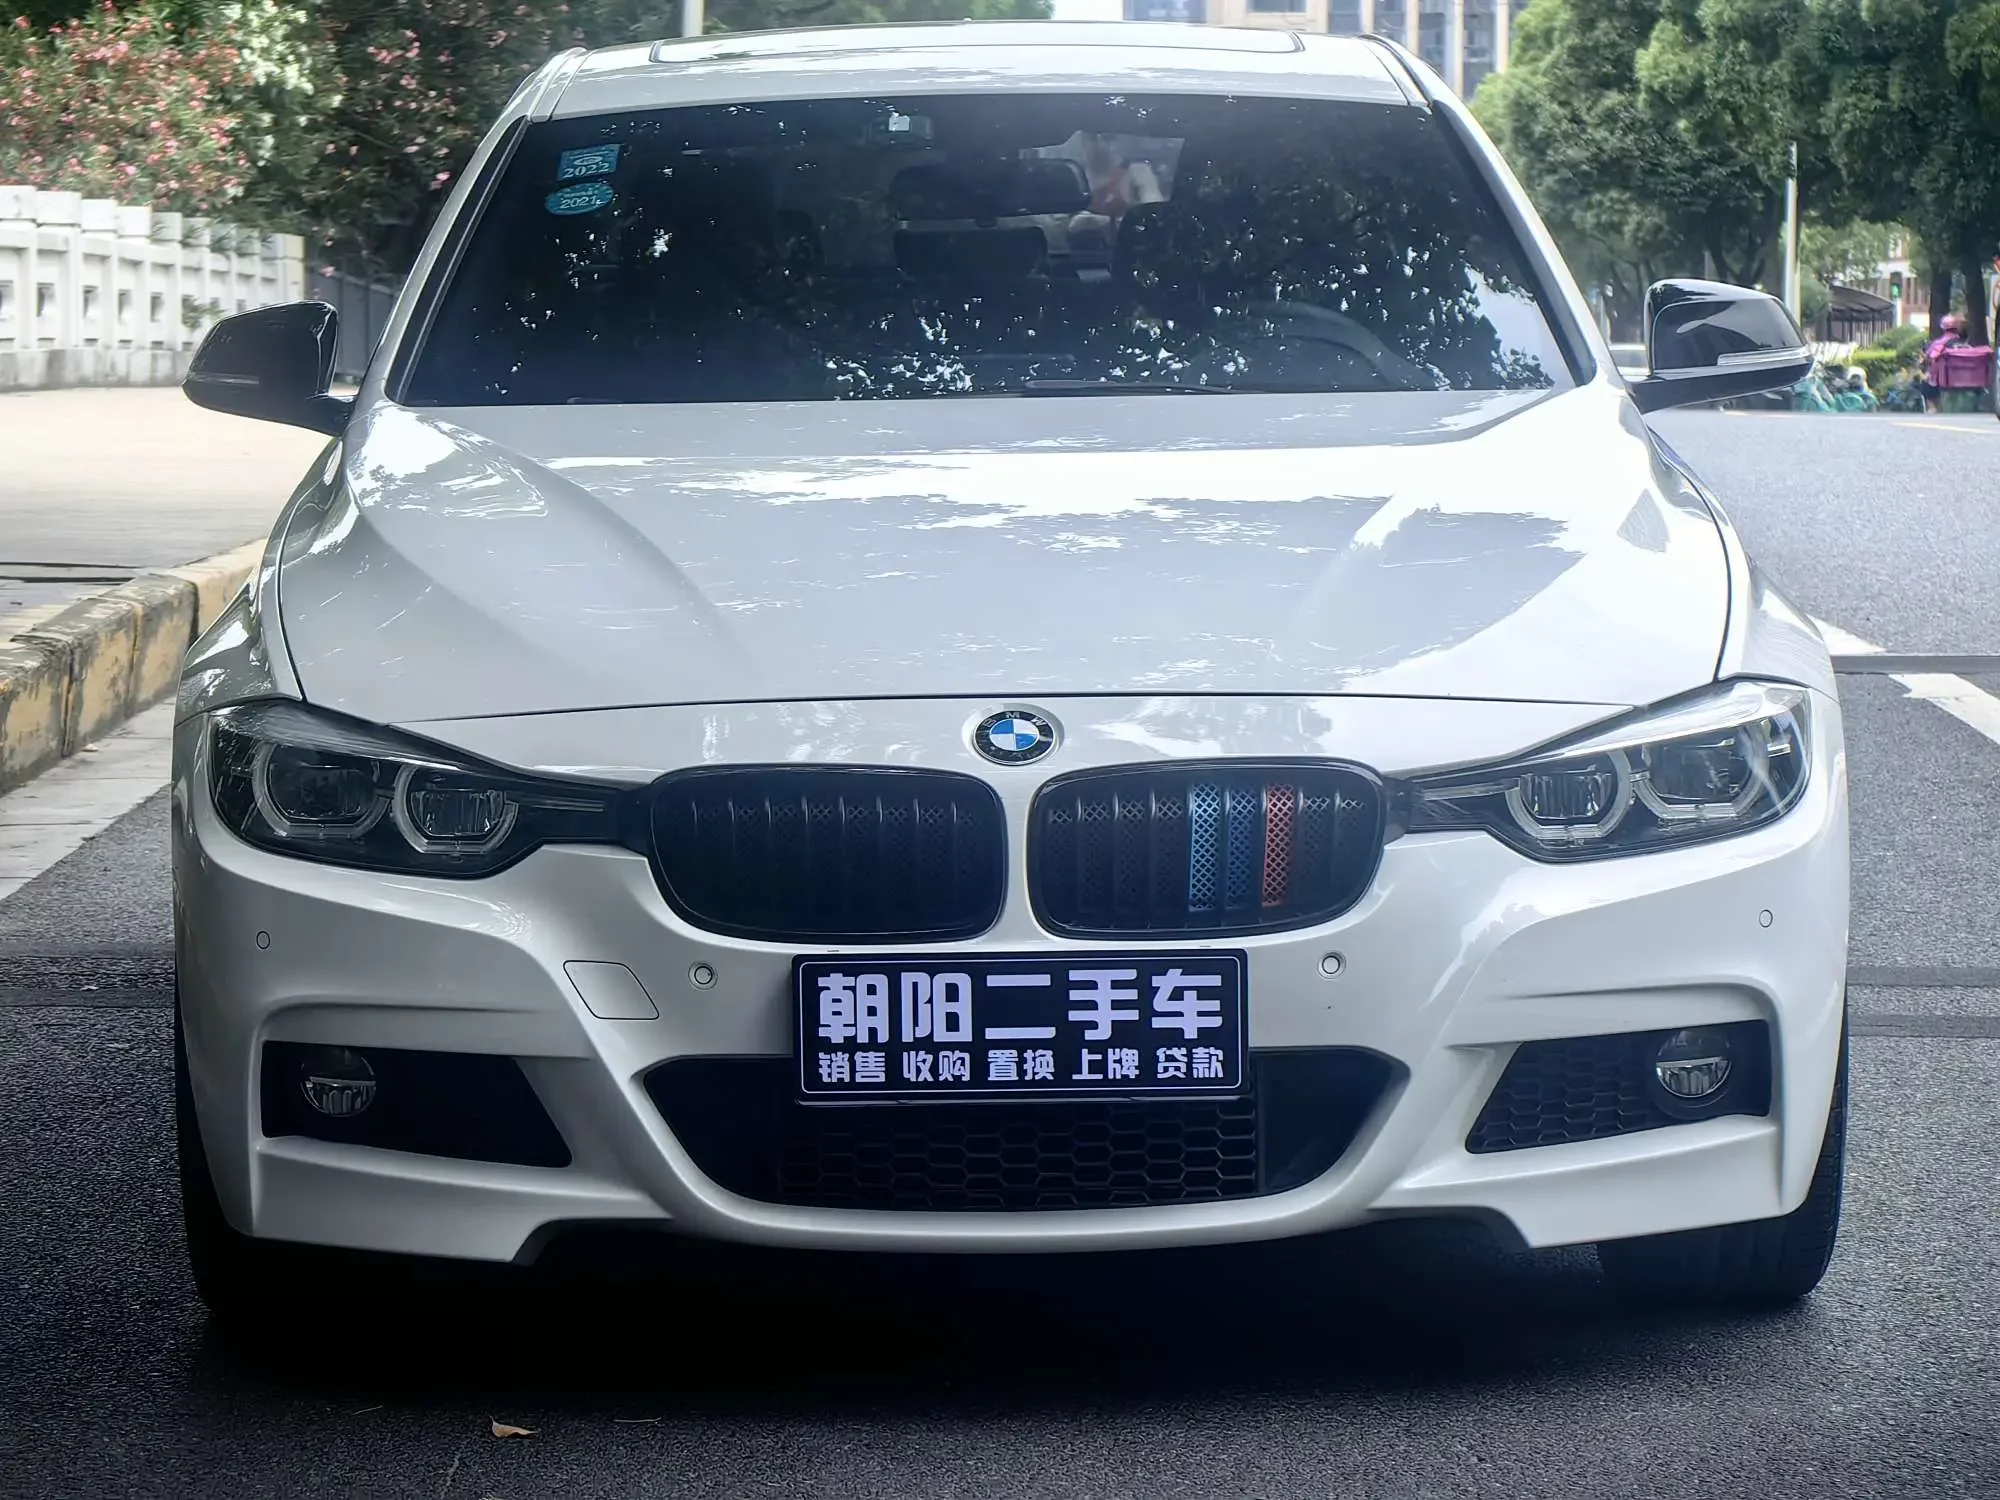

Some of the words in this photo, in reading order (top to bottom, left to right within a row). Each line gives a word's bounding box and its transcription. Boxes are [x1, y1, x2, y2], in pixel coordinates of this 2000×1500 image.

[560, 195, 597, 209] 2021
[981, 711, 1048, 728] BMW
[818, 969, 1223, 1043] 朝阳二手车
[818, 1052, 886, 1083] 销售
[903, 1051, 971, 1082] 收购
[987, 1050, 1055, 1081] 置换
[1072, 1048, 1140, 1080] 上牌
[1156, 1047, 1224, 1079] 贷款
